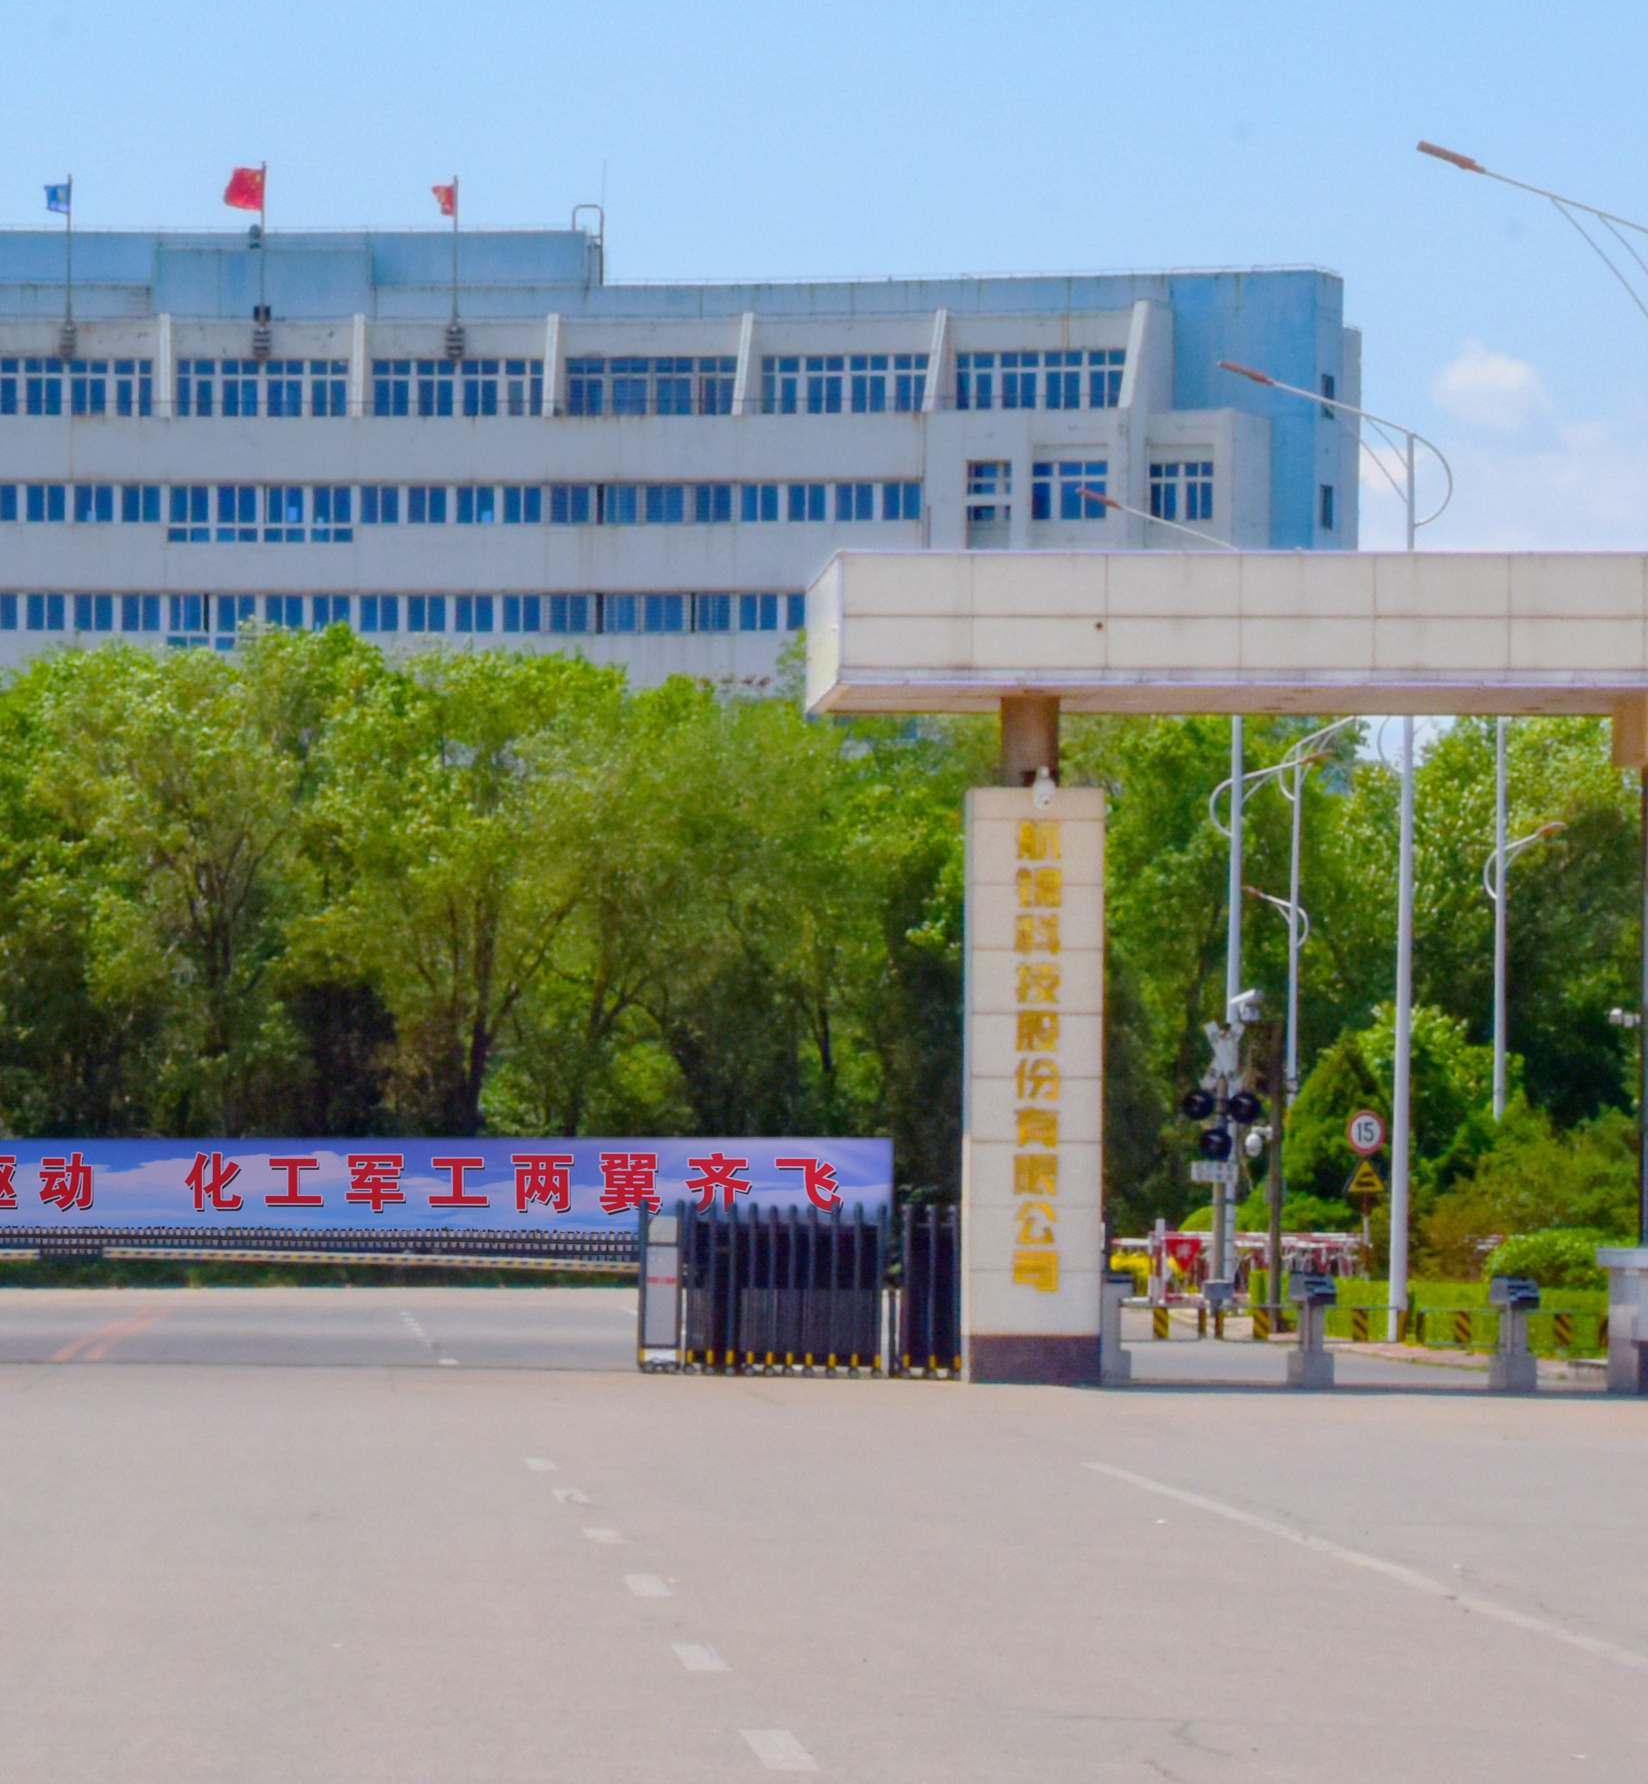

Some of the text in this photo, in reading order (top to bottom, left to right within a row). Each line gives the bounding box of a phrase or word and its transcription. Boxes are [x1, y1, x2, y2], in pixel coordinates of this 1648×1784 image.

[1012, 818, 1063, 1293] 航锦科技股份有限公司
[1357, 1122, 1375, 1143] 15
[184, 1152, 843, 1214] 化工军工两翼齐飞
